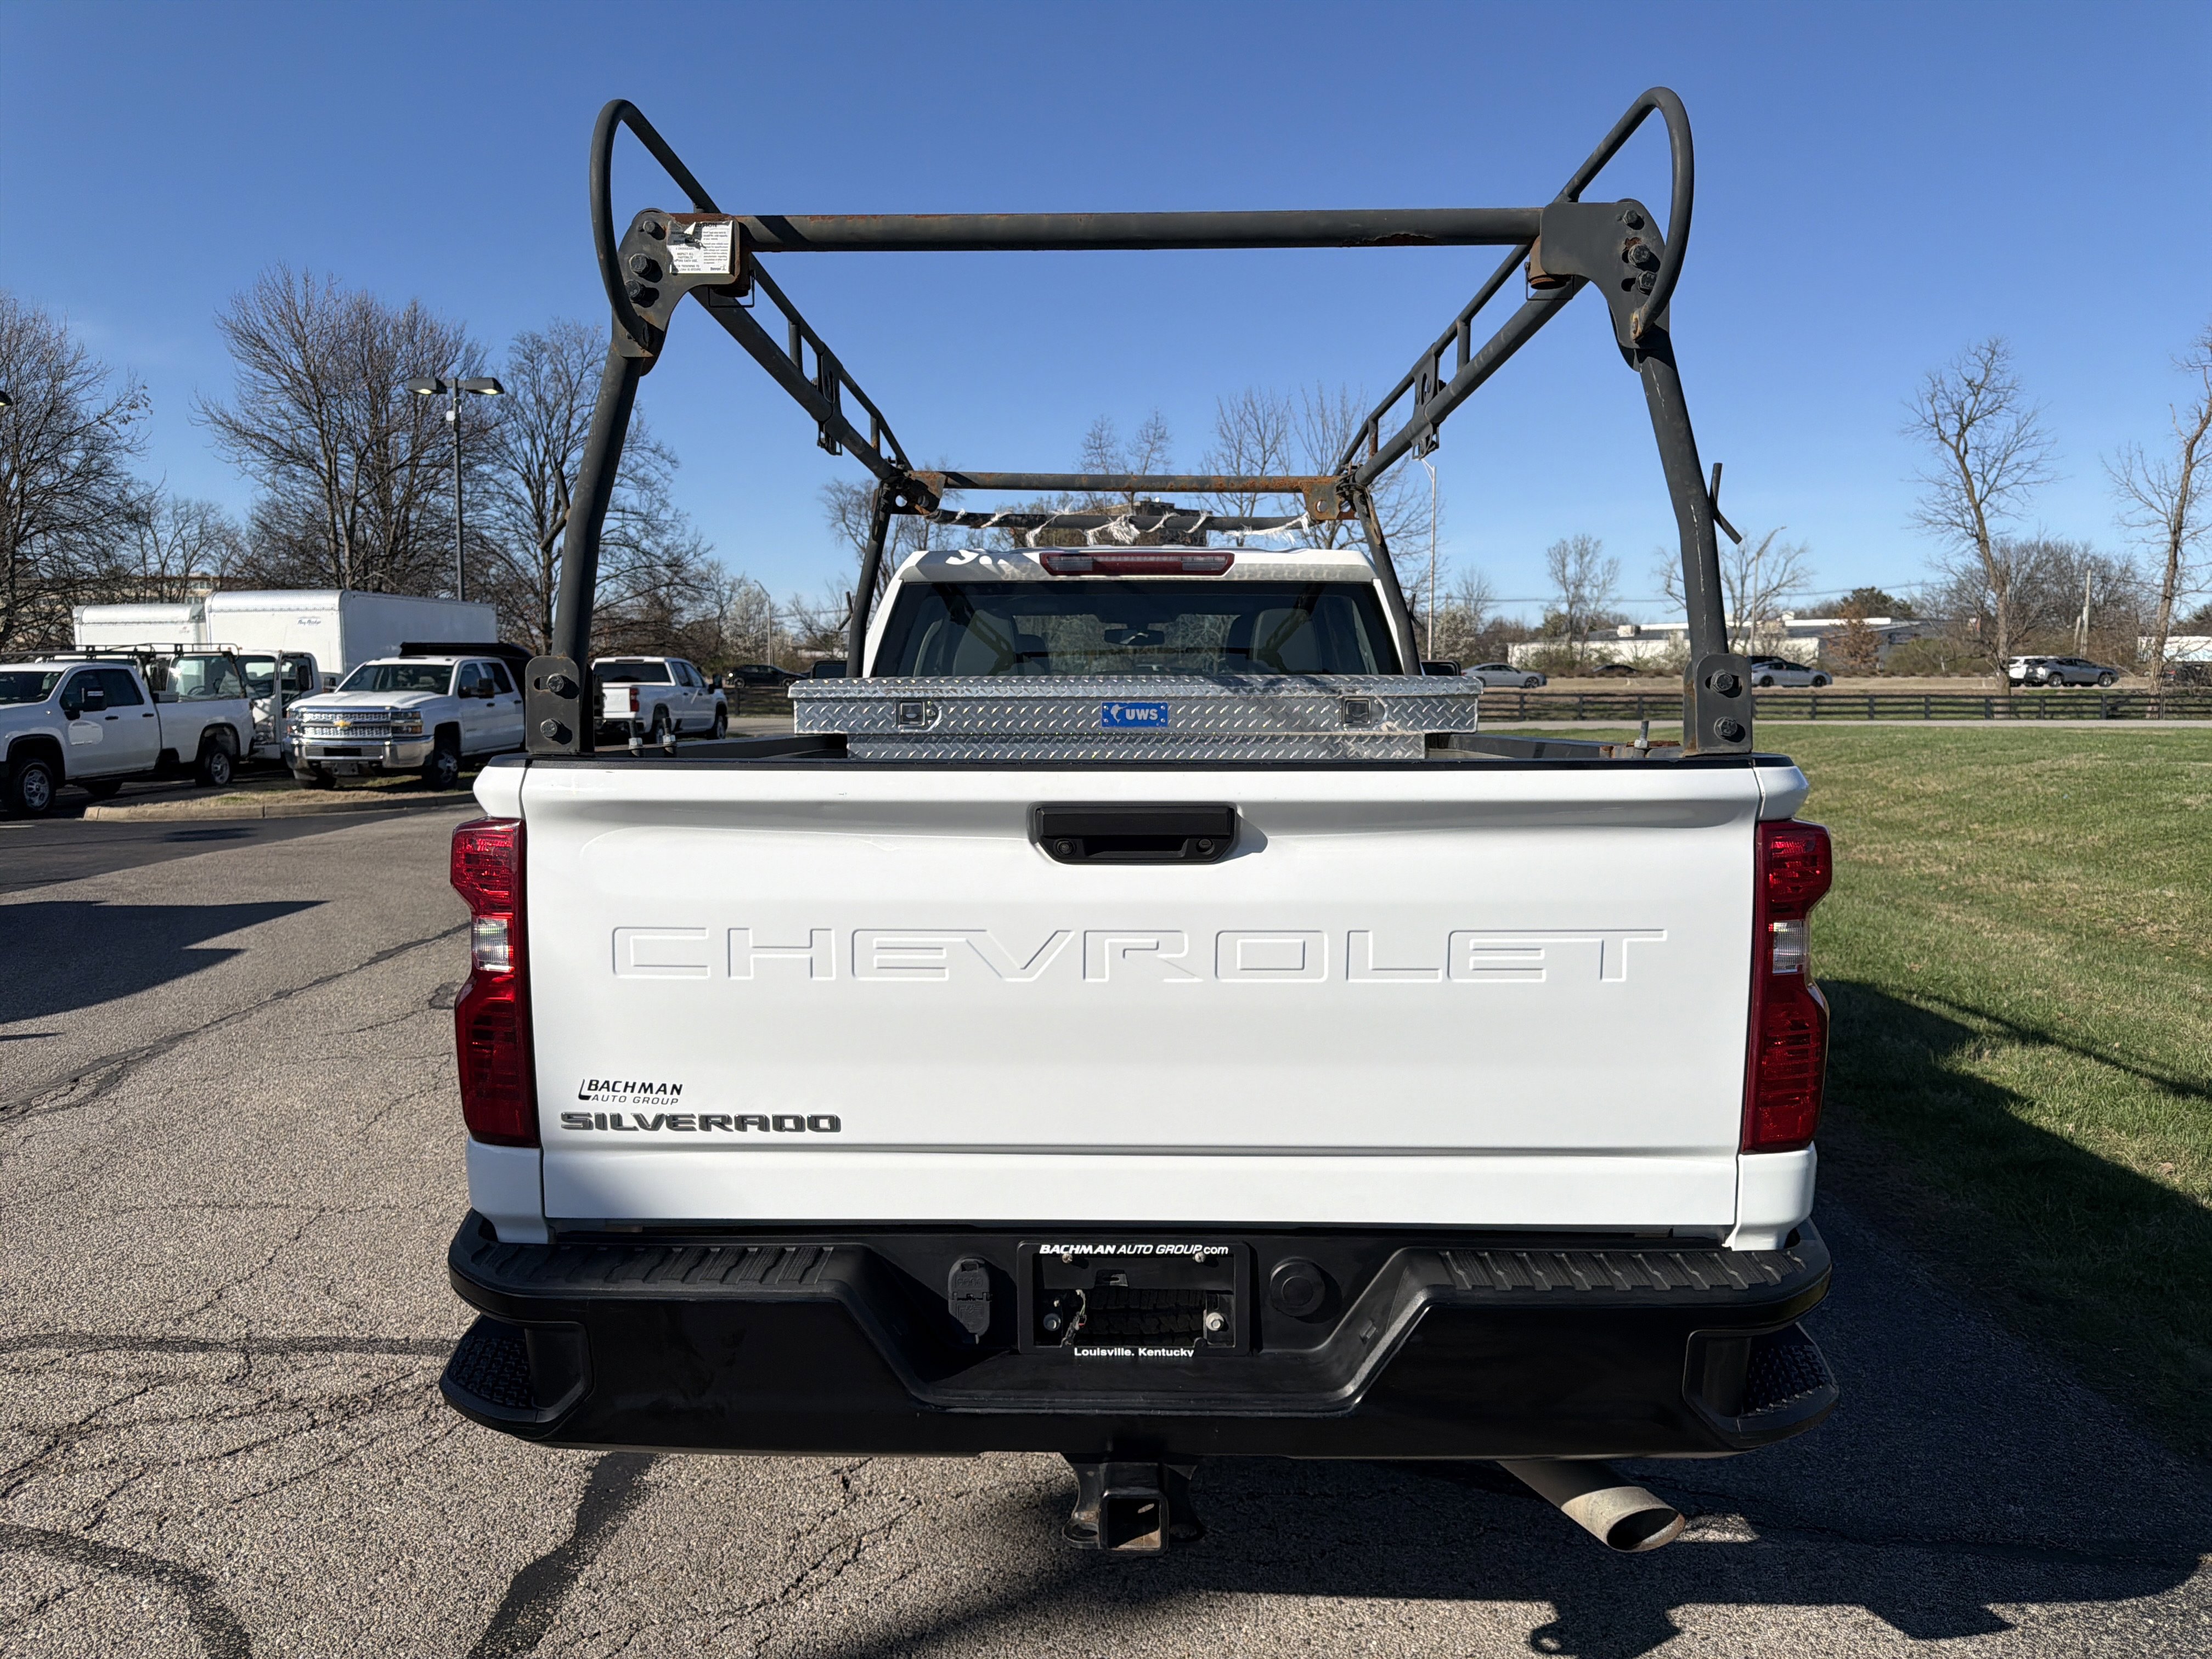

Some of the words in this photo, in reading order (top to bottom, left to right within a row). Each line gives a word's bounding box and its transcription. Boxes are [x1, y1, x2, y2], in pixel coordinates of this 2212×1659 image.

[1125, 708, 1158, 720] UWS
[612, 926, 1668, 983] CHEVROLET
[587, 1079, 683, 1096] BACHMAN
[590, 1093, 627, 1103] AUTO
[632, 1096, 679, 1106] GROUP
[561, 1111, 842, 1133] SILVERADO
[1039, 1244, 1116, 1255] BACHMAN
[1117, 1244, 1154, 1255] AUTO
[1155, 1244, 1229, 1255] GROUPcom
[1138, 1347, 1194, 1358] Kentucky
